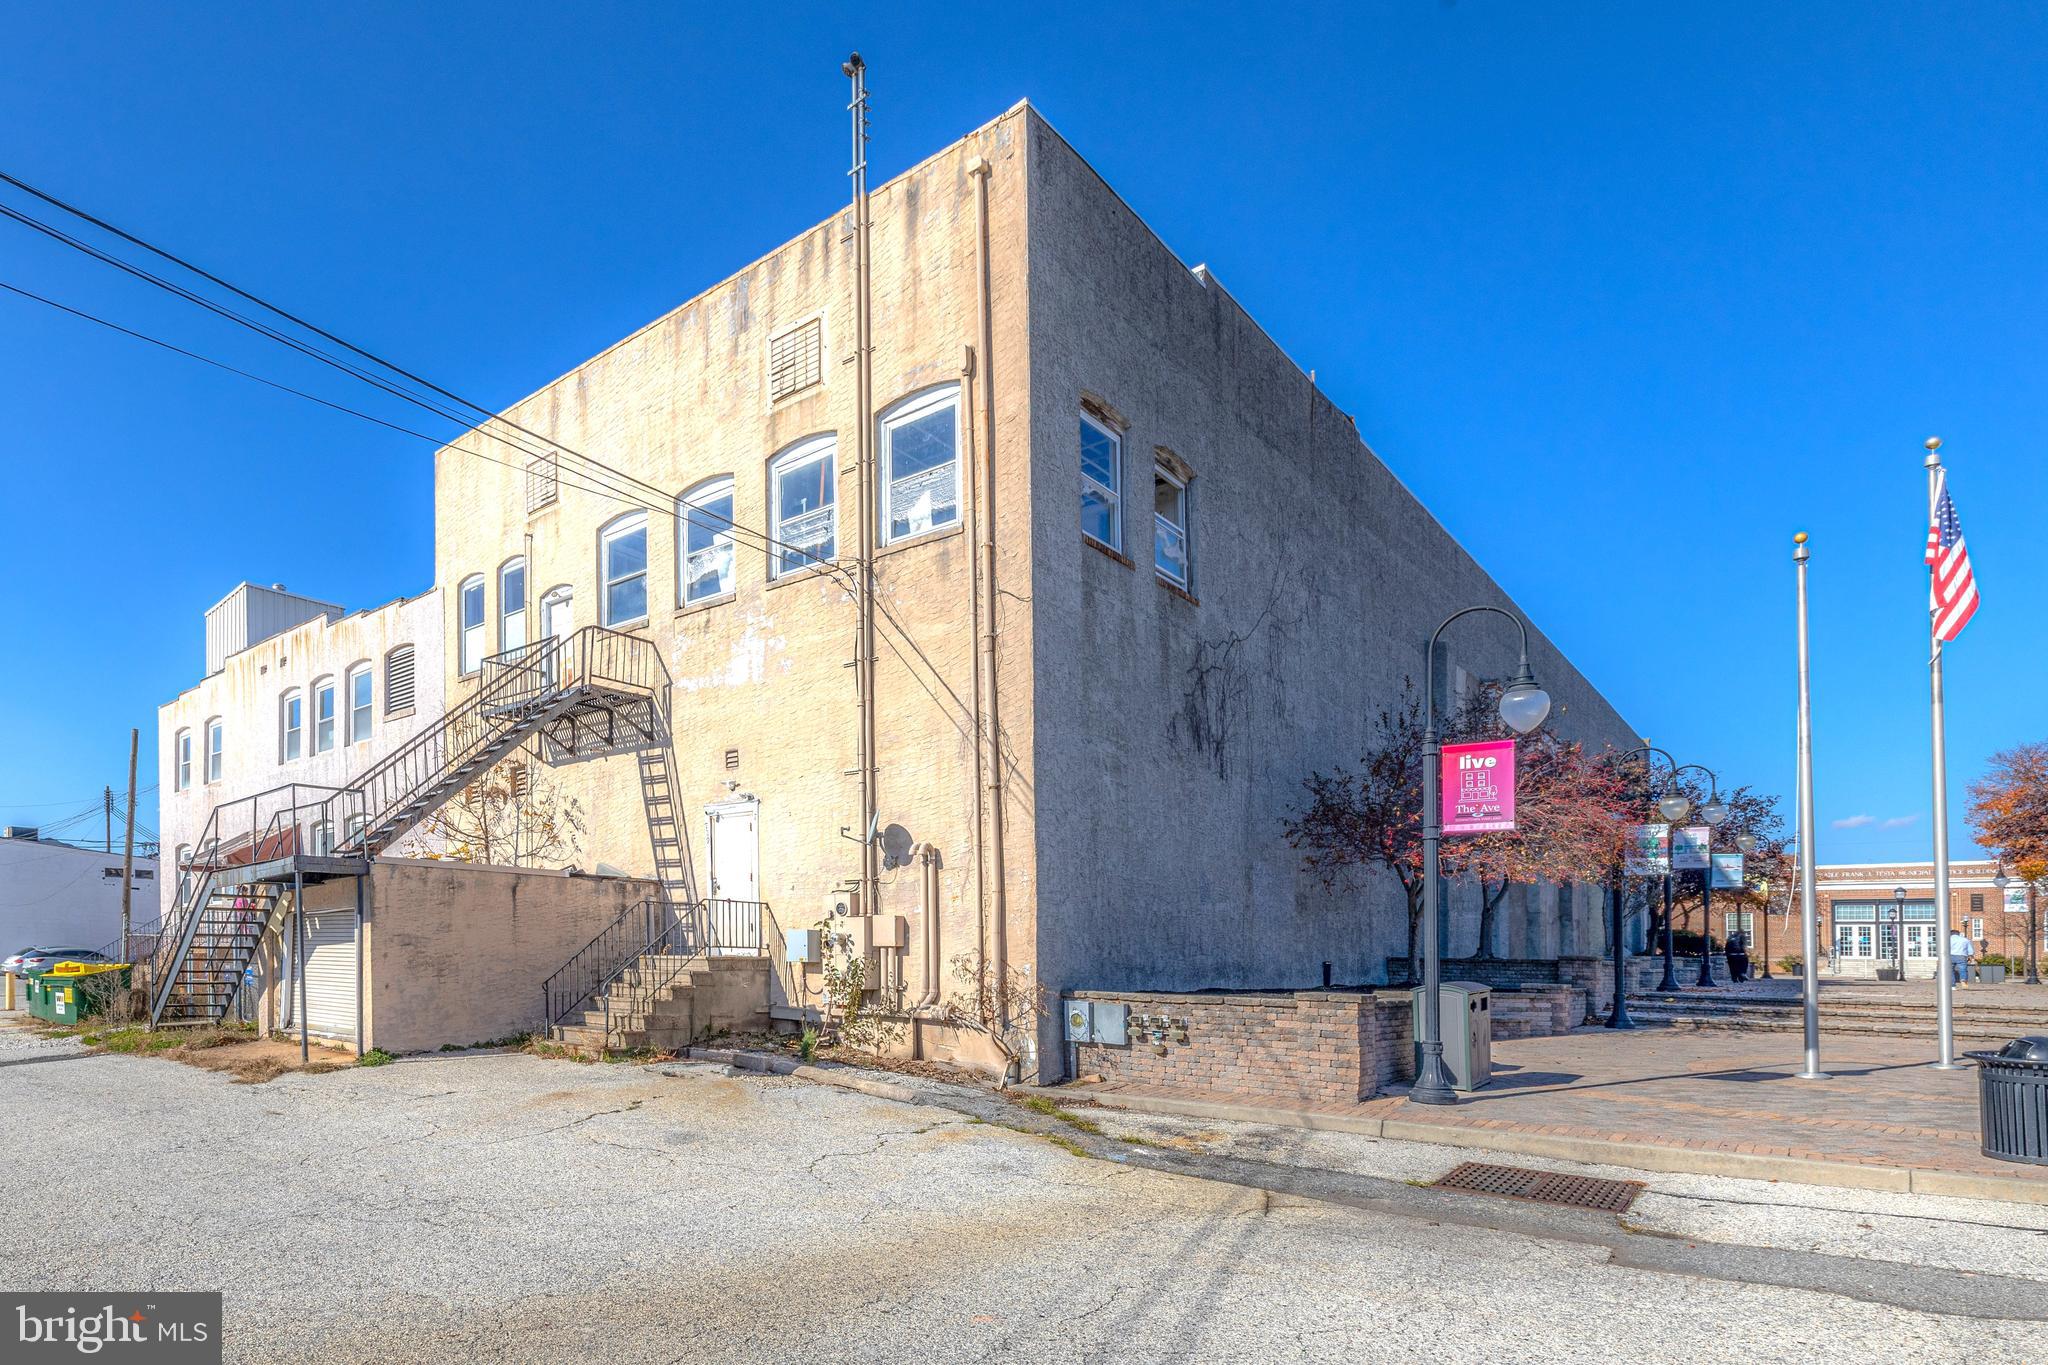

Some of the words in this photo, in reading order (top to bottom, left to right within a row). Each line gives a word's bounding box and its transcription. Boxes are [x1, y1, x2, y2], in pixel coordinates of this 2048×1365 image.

[1459, 754, 1497, 770] live
[1455, 804, 1476, 814] The
[1480, 803, 1500, 812] Ave
